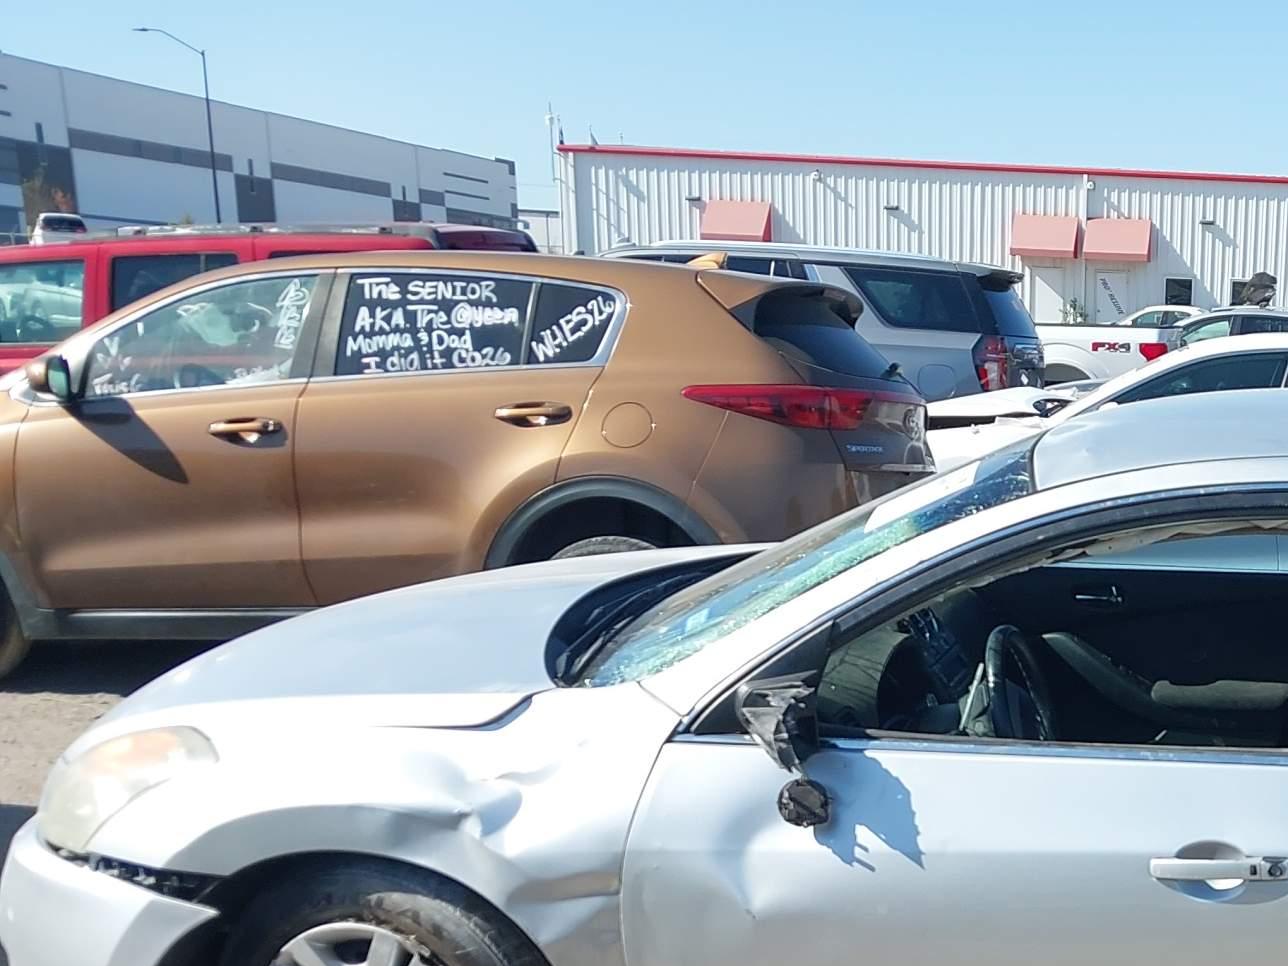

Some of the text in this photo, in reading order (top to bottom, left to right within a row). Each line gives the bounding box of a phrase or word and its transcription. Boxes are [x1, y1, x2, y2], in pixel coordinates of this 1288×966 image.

[356, 278, 497, 302] The SENIOR
[407, 305, 451, 329] The
[346, 335, 414, 357] Momma
[432, 329, 473, 352] Dad
[1092, 342, 1131, 353] FX4
[361, 357, 384, 374] I
[386, 351, 420, 372] did
[426, 351, 446, 369] it
